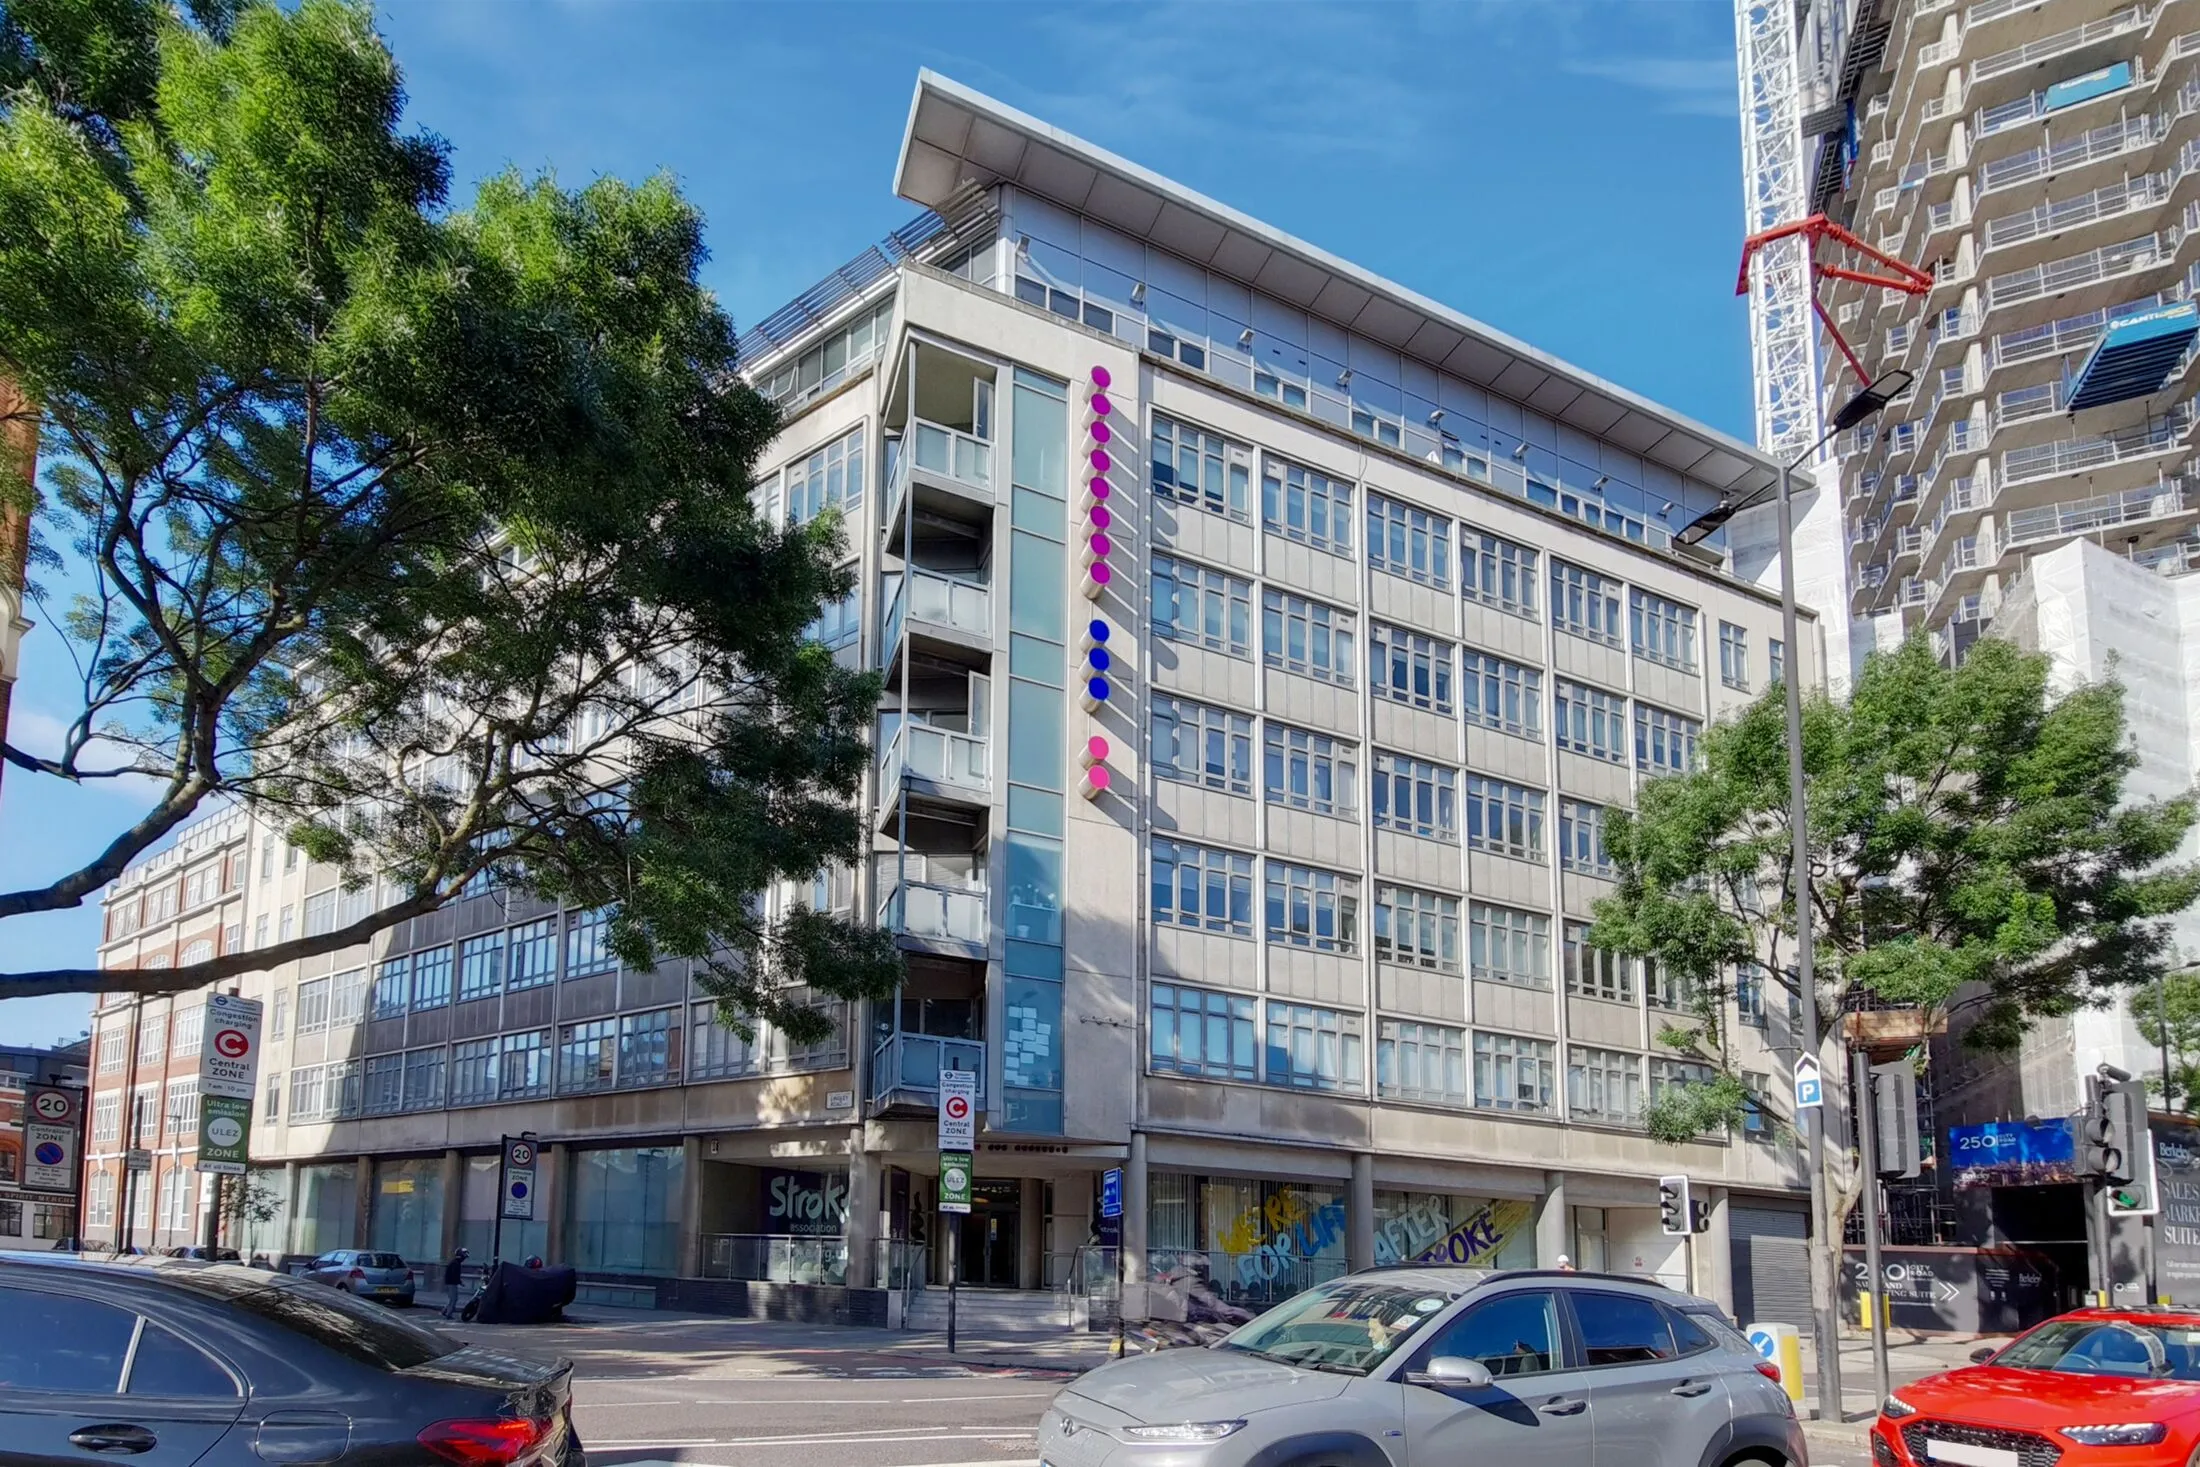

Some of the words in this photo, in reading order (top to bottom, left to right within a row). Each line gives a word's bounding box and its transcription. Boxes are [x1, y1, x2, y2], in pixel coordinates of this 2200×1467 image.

[210, 1008, 258, 1023] Congestion
[214, 1018, 252, 1030] charging
[209, 1057, 250, 1071] Central
[212, 1067, 245, 1079] ZONE
[1802, 1083, 1815, 1102] P
[39, 1098, 66, 1113] 20
[206, 1099, 230, 1109] Ultra
[232, 1102, 248, 1111] low
[207, 1109, 246, 1118] emission
[943, 1120, 970, 1128] Central
[36, 1132, 64, 1142] ZONE
[211, 1127, 239, 1137] ULEZ
[945, 1127, 967, 1135] ZONE
[1960, 1135, 1996, 1151] 250
[207, 1147, 240, 1159] ZONE
[514, 1148, 530, 1160] 20
[2159, 1142, 2190, 1164] Berkeley
[943, 1192, 966, 1201] ZONE
[789, 1223, 837, 1233] association
[1373, 1195, 1450, 1266] AFTER
[2164, 1226, 2200, 1246] SUITE
[1238, 1232, 1300, 1286] FOR
[1854, 1262, 1906, 1281] 20
[1884, 1281, 1903, 1289] AND
[1908, 1290, 1937, 1299] SUITE
